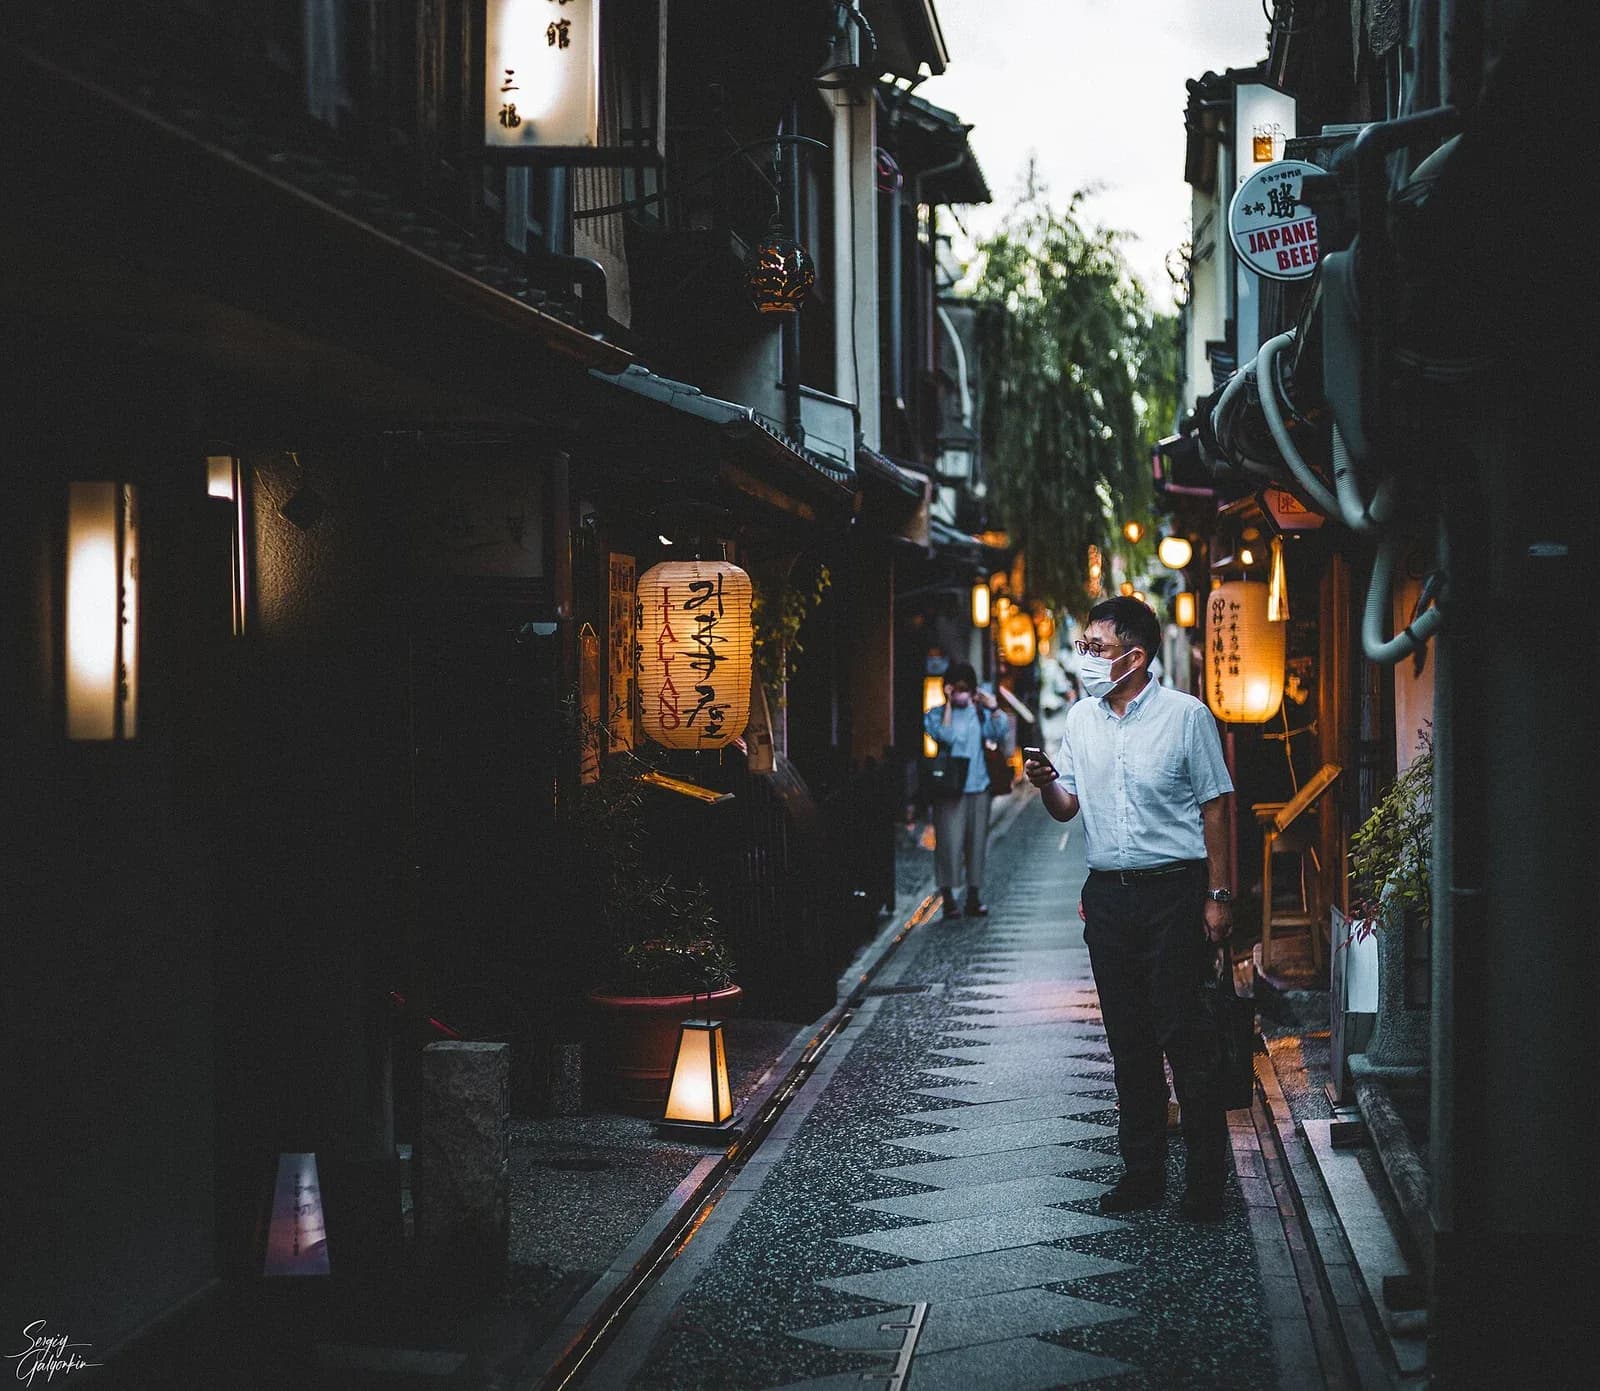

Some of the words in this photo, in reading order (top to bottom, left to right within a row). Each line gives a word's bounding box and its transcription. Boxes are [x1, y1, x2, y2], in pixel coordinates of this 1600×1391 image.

[545, 0, 574, 50] 館
[498, 69, 521, 128] 三福
[1241, 201, 1266, 216] 京都
[1248, 220, 1317, 254] JAPANE
[1276, 242, 1318, 271] BEEF
[655, 586, 681, 730] ITALIANO
